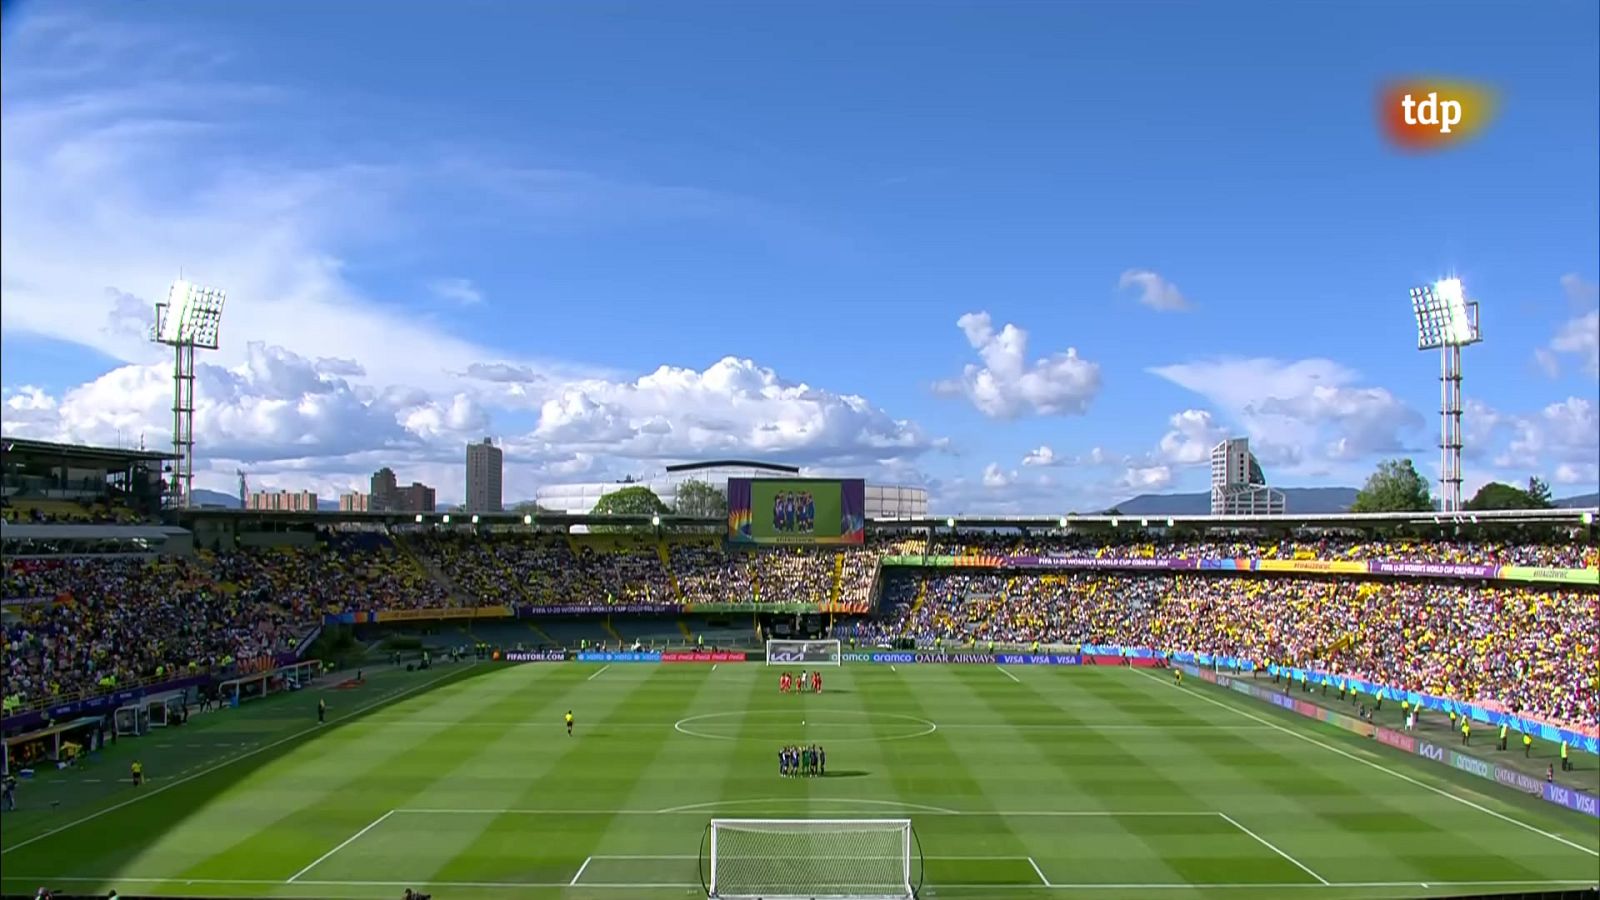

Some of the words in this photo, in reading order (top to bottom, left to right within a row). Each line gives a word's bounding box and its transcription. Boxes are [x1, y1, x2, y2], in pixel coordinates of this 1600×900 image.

[506, 653, 565, 661] FIFASTORE.COM
[831, 653, 870, 661] aamco
[873, 653, 912, 661] aramco
[914, 653, 949, 663] QATAR
[952, 653, 996, 663] AIRWAYS
[1004, 655, 1024, 664] VISA
[1030, 655, 1050, 664] VISA
[1056, 655, 1076, 664] VISA
[1456, 754, 1488, 776] aramco
[1550, 784, 1569, 807] VISA
[1574, 792, 1595, 815] VISA
